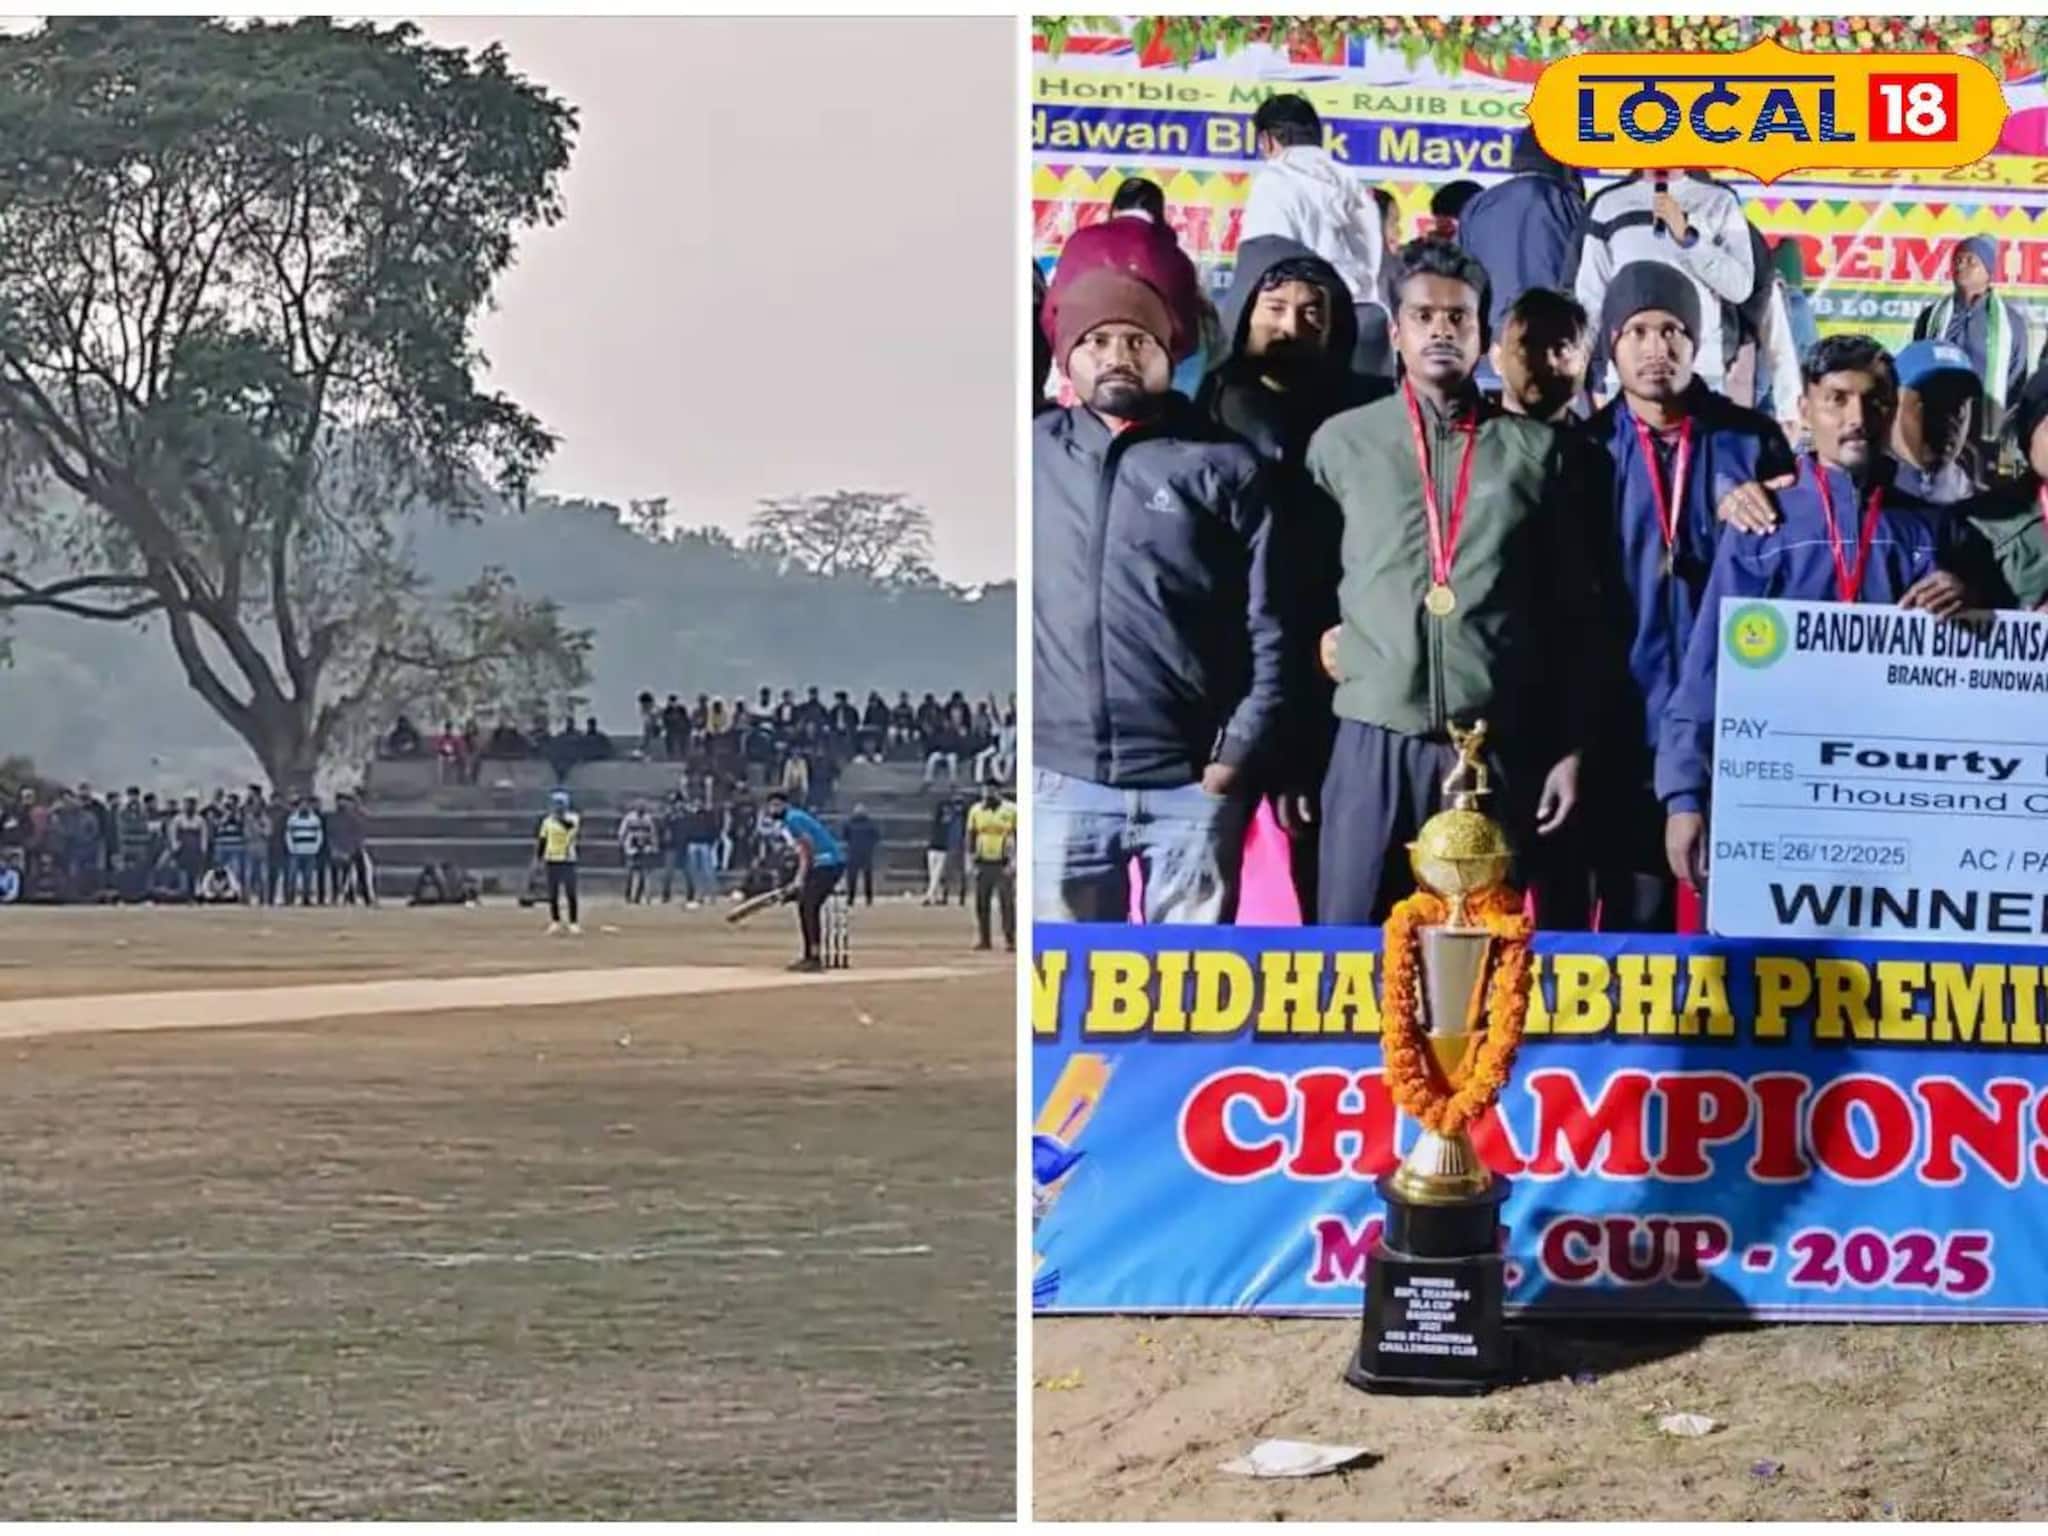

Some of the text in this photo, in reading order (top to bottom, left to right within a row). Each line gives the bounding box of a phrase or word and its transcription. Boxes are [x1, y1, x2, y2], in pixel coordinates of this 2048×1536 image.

[1353, 92, 1447, 115] RAJIB
[1206, 116, 1350, 161] Blk
[1378, 125, 1513, 177] Mayd
[1763, 233, 2048, 285] REMIE
[1795, 611, 1927, 656] BANDWAN
[1888, 665, 1957, 688] BRANCH
[1721, 718, 1769, 739] PAY
[1719, 742, 2022, 781] RUPEES Fourty
[1804, 781, 2008, 812] Thousand
[1716, 840, 1776, 862] DATE
[1782, 843, 1906, 866] 26/12/2025
[1959, 849, 1998, 871] AC
[1180, 1069, 2048, 1186] CHMPION
[1542, 1218, 1730, 1283] CUP
[1791, 1231, 1990, 1295] 2025
